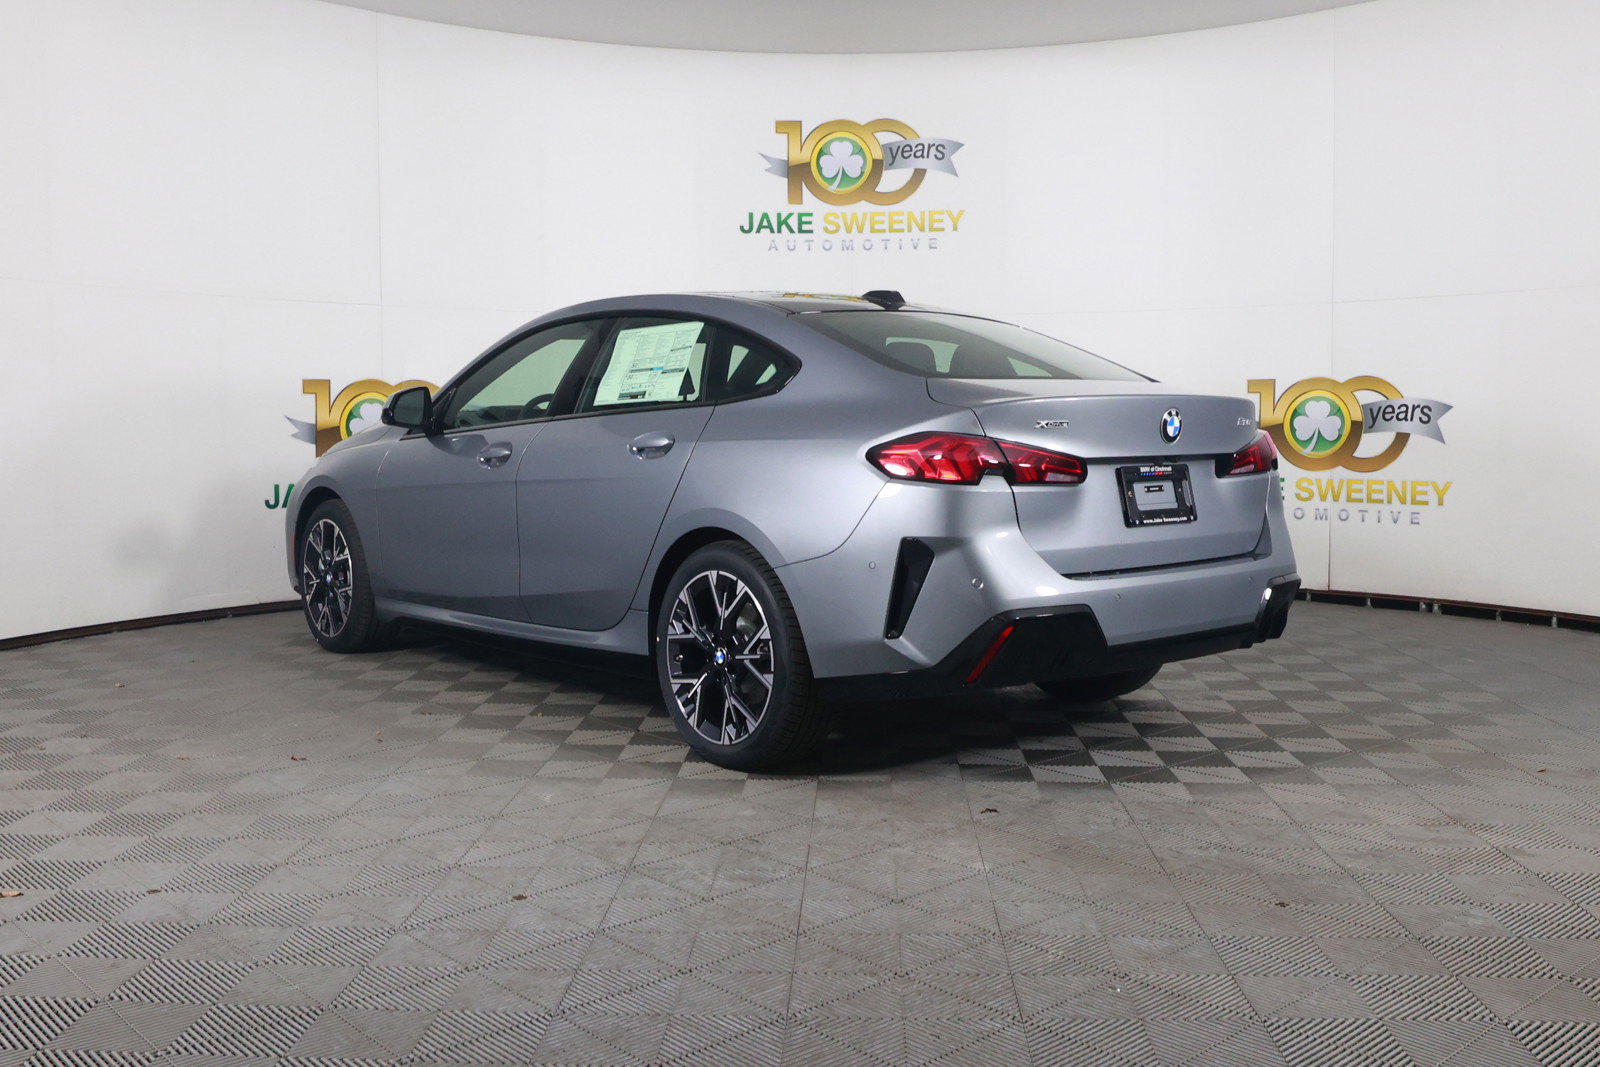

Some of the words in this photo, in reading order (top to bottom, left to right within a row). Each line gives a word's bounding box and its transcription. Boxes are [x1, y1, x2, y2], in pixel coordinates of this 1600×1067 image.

[775, 118, 927, 206] 100
[889, 142, 946, 166] years
[739, 212, 814, 235] JAKE
[822, 210, 965, 234] SWEENEY
[768, 238, 938, 251] AUTOMOTIVE
[1247, 375, 1411, 473] 100
[1368, 403, 1433, 429] years
[1294, 478, 1453, 506] SWEENEY
